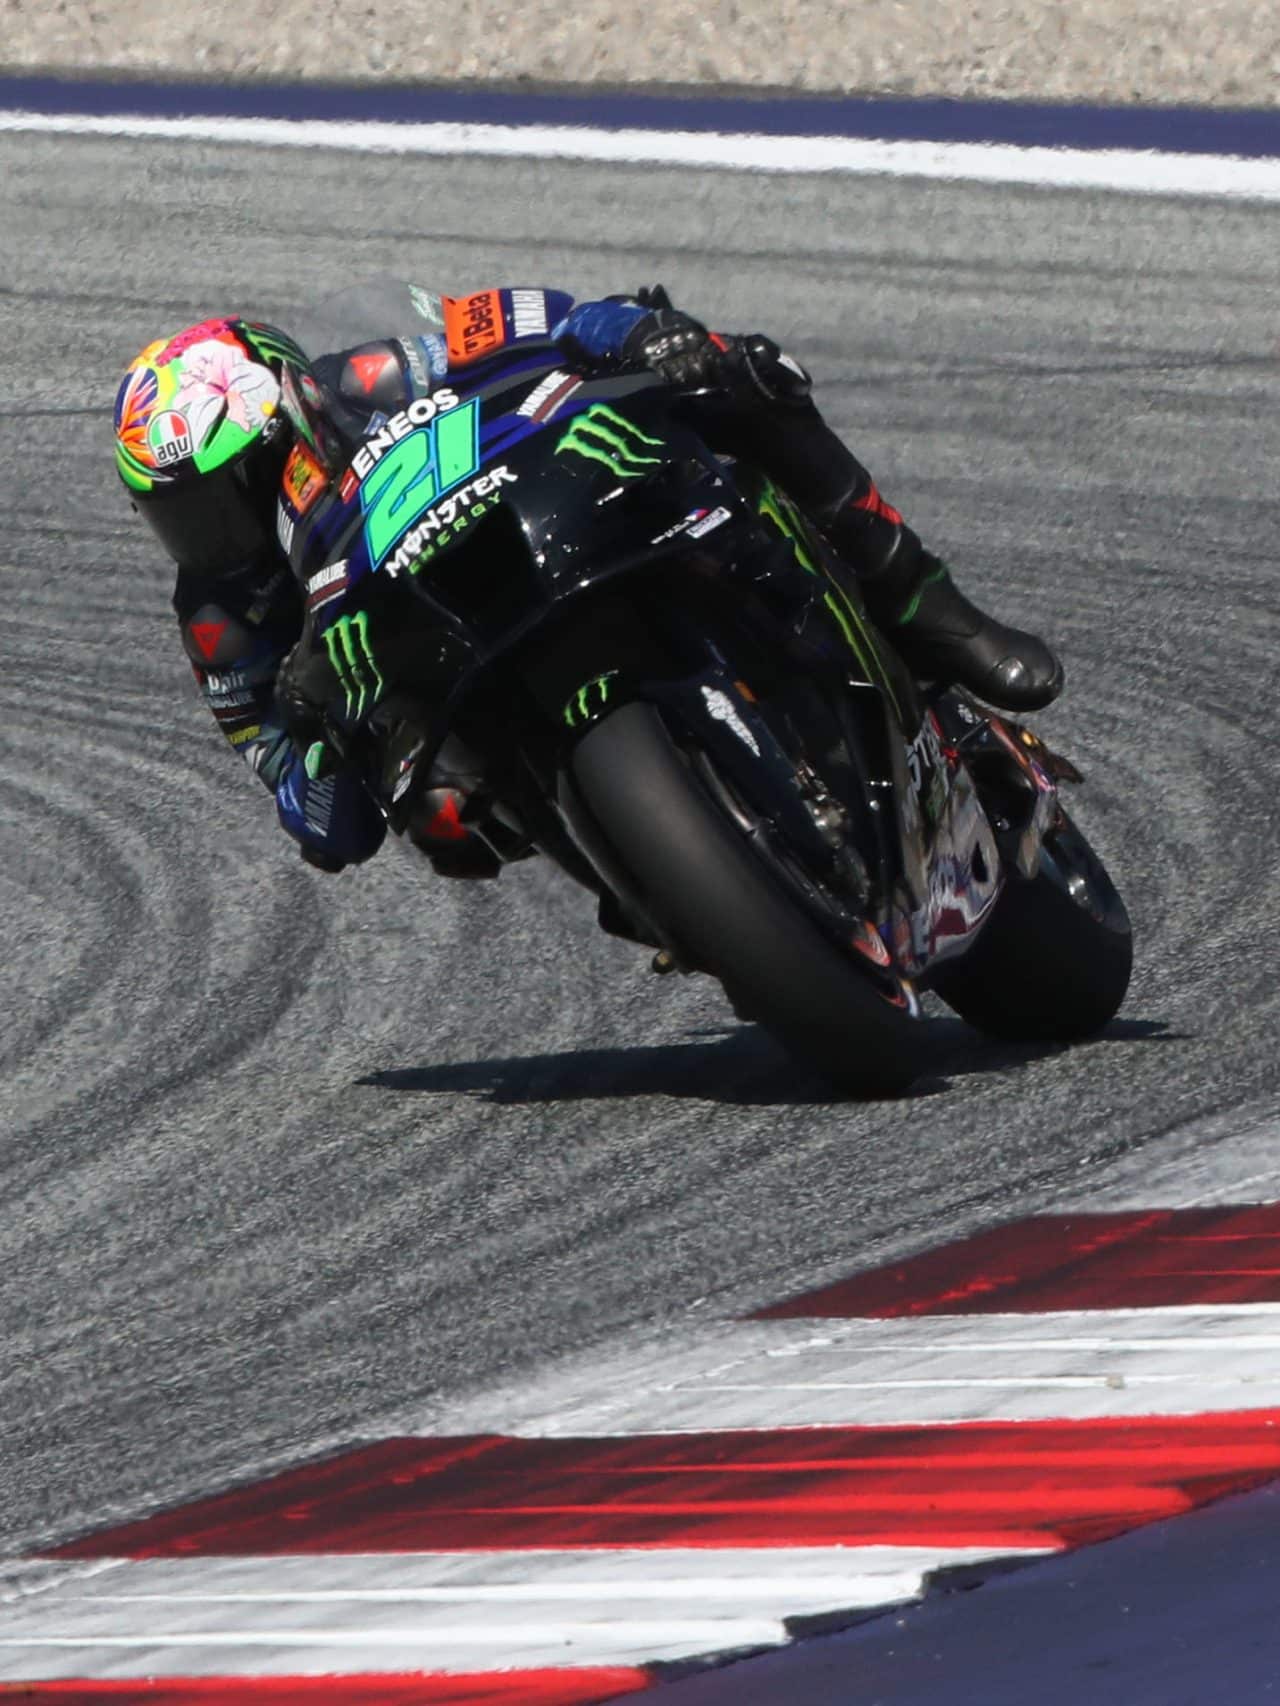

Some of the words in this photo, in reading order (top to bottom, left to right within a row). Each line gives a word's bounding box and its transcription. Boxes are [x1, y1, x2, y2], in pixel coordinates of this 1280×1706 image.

[351, 388, 459, 480] ENEOS
[359, 396, 480, 573] 21
[385, 465, 519, 578] MONSTER
[408, 491, 501, 575] ENERGY
